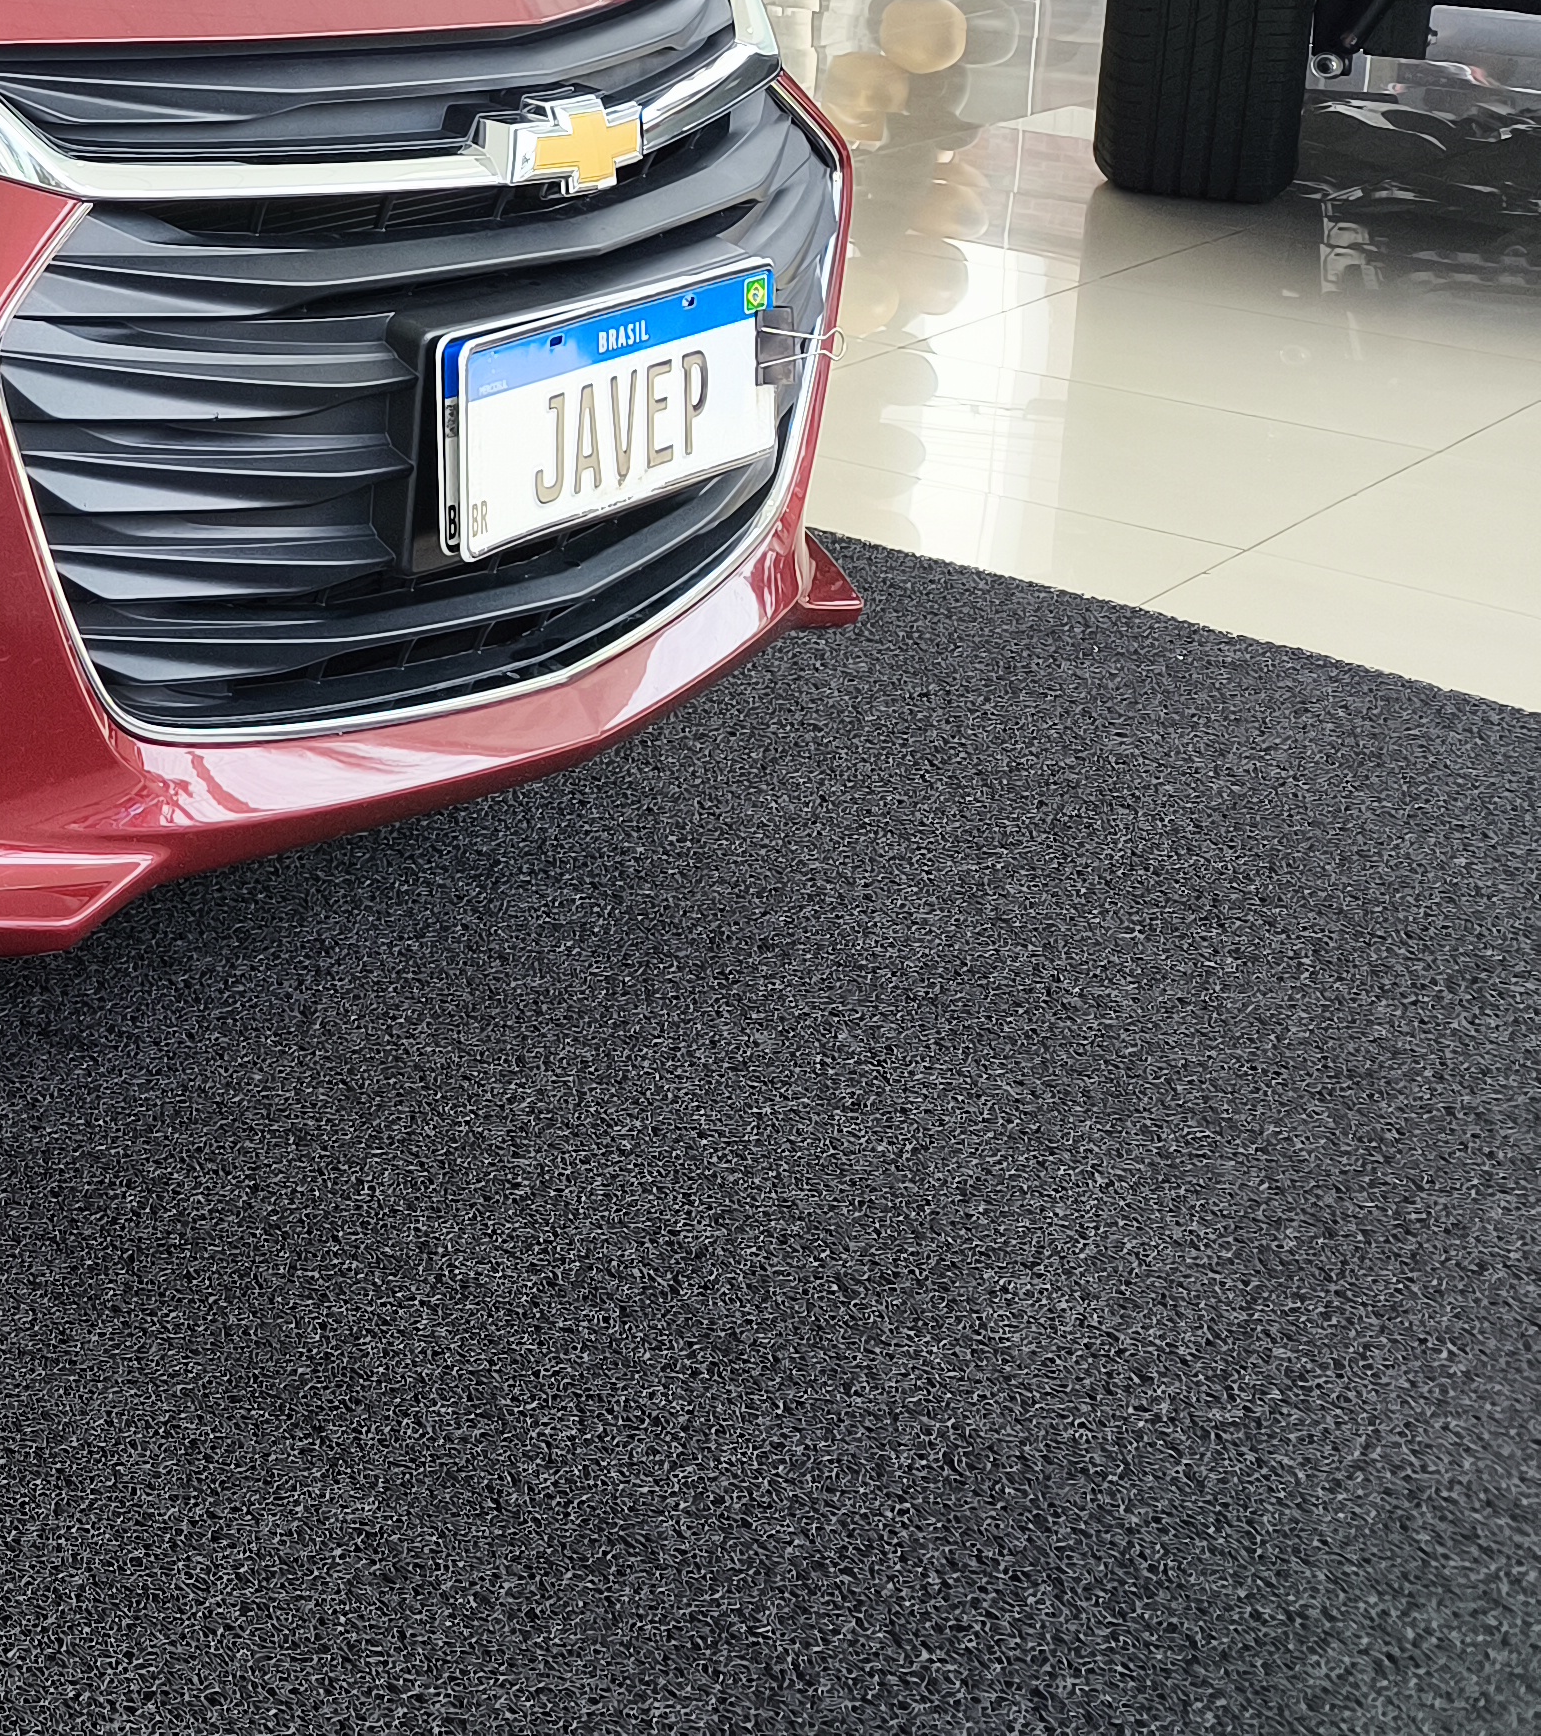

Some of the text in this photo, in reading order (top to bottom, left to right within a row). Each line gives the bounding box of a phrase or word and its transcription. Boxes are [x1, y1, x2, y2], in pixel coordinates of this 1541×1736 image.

[598, 319, 649, 354] BRASIL
[534, 349, 709, 505] JAVEP
[471, 499, 488, 538] BR
